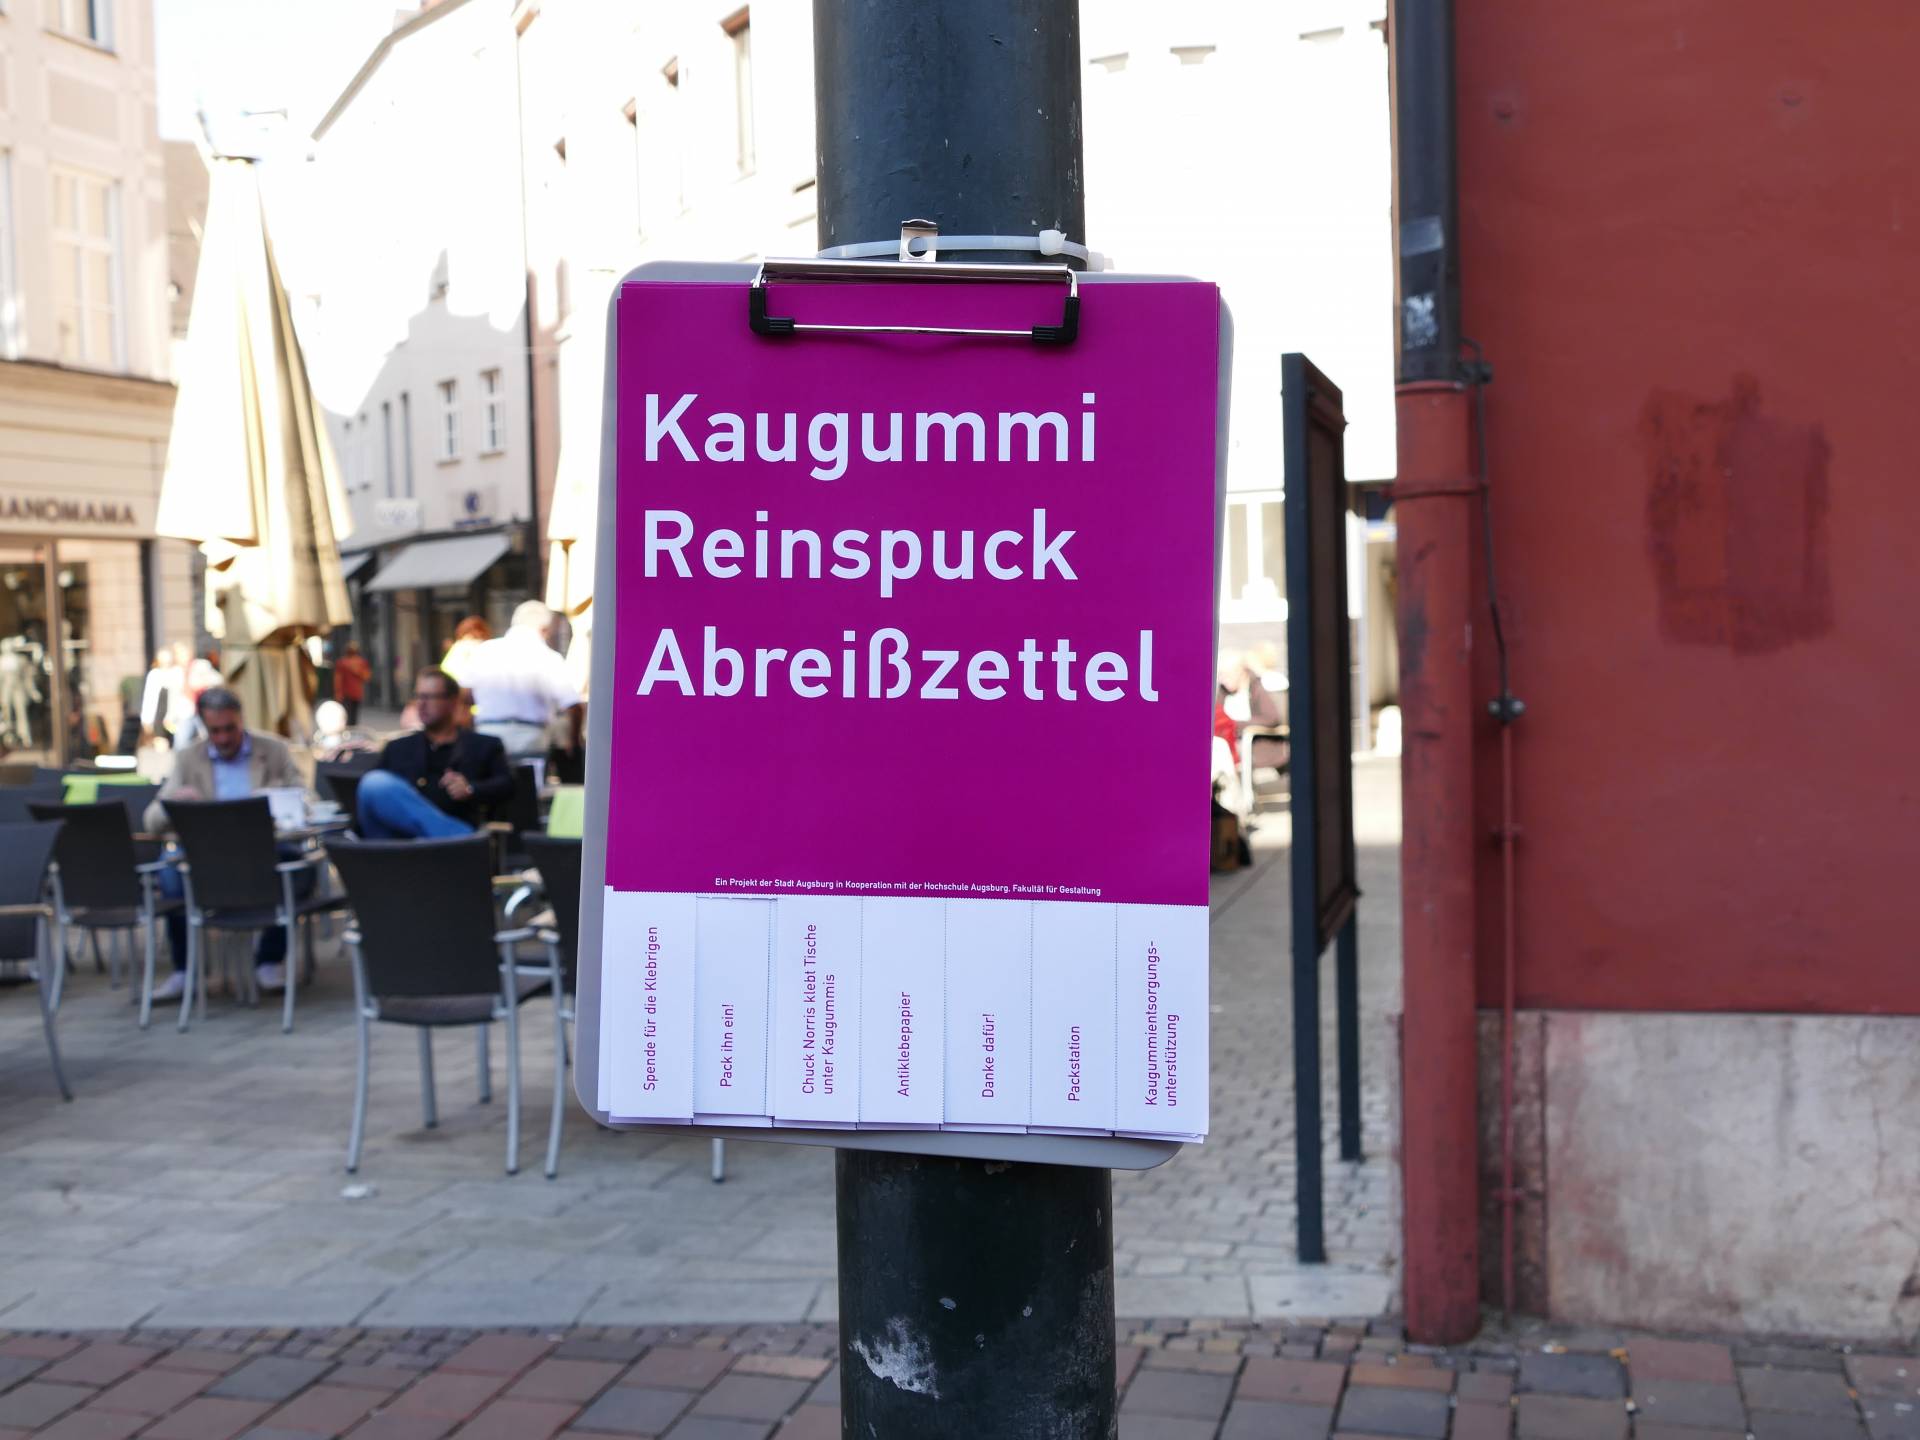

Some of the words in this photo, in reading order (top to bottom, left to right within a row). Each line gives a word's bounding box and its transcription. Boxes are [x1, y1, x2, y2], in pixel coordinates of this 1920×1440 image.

[645, 392, 1096, 481] Kaugummi
[0, 496, 136, 526] ANOMAMA
[644, 508, 1079, 598] Reinspuck
[636, 626, 1159, 702] Abreißzettel
[715, 878, 728, 887] Ein
[729, 878, 758, 888] Projekt
[759, 878, 773, 888] der
[774, 879, 795, 888] Stadt
[796, 879, 834, 890] Augsburg
[836, 880, 844, 889] in
[845, 880, 892, 890] Kooperation
[894, 881, 907, 890] mit
[909, 881, 923, 890] der
[924, 881, 969, 892] Hochschule
[1012, 884, 1045, 894] Fakultät
[1046, 885, 1058, 894] für
[1059, 885, 1102, 897] Gestaltung
[644, 926, 661, 991] Klebrigen
[803, 923, 817, 967] Tische
[643, 995, 657, 1015] die
[803, 970, 816, 1003] klebt
[643, 1018, 657, 1038] für
[721, 1003, 734, 1028] ein!
[802, 1007, 816, 1049] Norris
[821, 974, 839, 1056] Kaugummis
[981, 1013, 996, 1052] dafür!
[1144, 940, 1161, 1106] Kaugummientsorgungs-
[720, 1032, 734, 1052] ihn
[896, 991, 914, 1097] Antiklebepapier
[1164, 1014, 1180, 1107] unterstützung
[642, 1041, 659, 1092] Spende
[719, 1055, 733, 1087] Pack
[801, 1053, 815, 1094] Chuck
[821, 1058, 834, 1095] unter
[981, 1056, 995, 1098] Danke
[1067, 1025, 1081, 1102] Packstation
